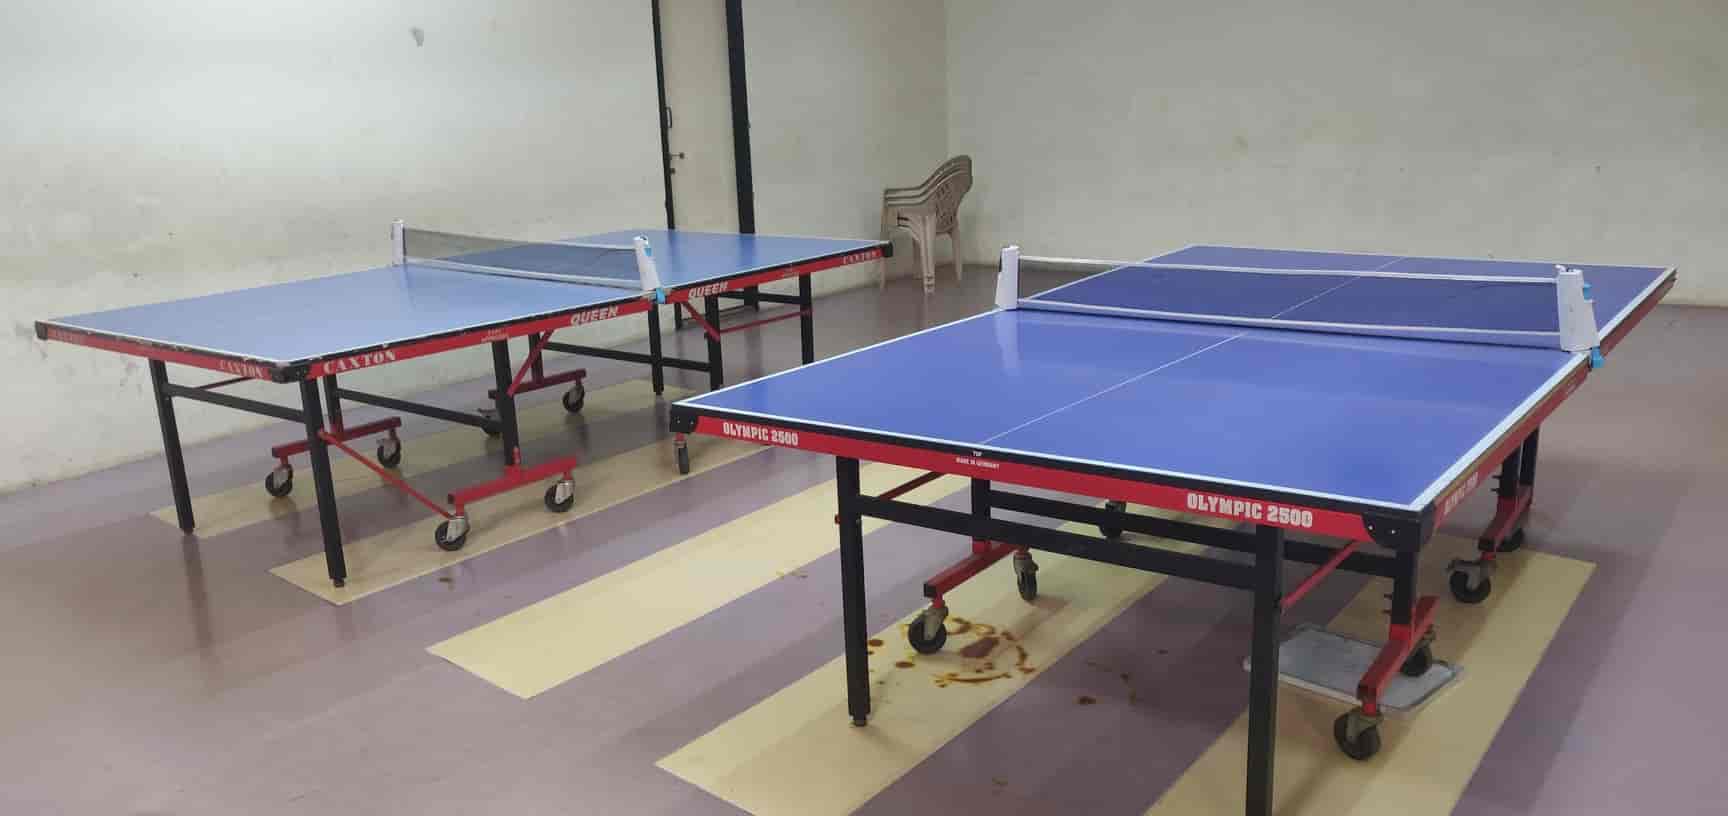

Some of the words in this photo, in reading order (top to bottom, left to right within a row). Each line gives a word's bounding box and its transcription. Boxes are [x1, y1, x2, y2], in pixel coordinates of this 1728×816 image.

[688, 281, 729, 298] QUEEN
[570, 305, 619, 327] QUEEN
[219, 360, 264, 379] CAXTON
[323, 352, 397, 375] CAXTON
[723, 422, 769, 442] OLYMPIC
[771, 430, 799, 447] 2500
[1187, 492, 1263, 520] OLYMPIC
[1267, 504, 1313, 528] 2500
